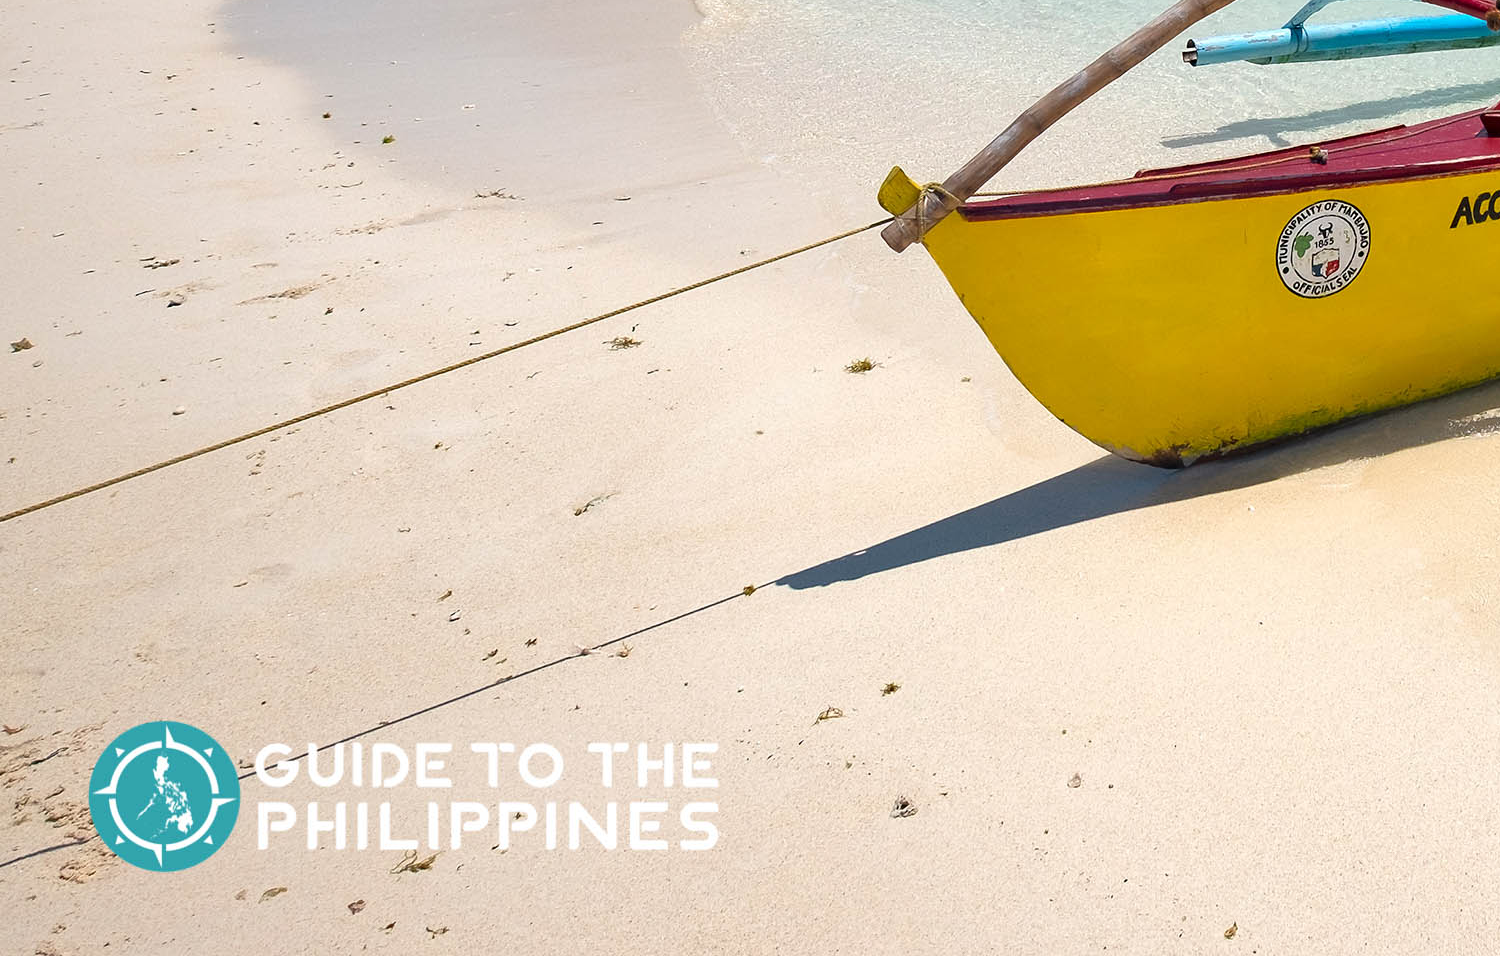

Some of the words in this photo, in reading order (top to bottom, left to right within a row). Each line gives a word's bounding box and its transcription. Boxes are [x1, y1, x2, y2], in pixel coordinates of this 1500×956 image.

[1279, 204, 1322, 265] MUNICIPALITY
[1324, 202, 1338, 212] OF
[1339, 204, 1369, 249] MAMBAJAO
[1292, 281, 1336, 295] OFFICIAL
[1336, 266, 1357, 288] SEAL
